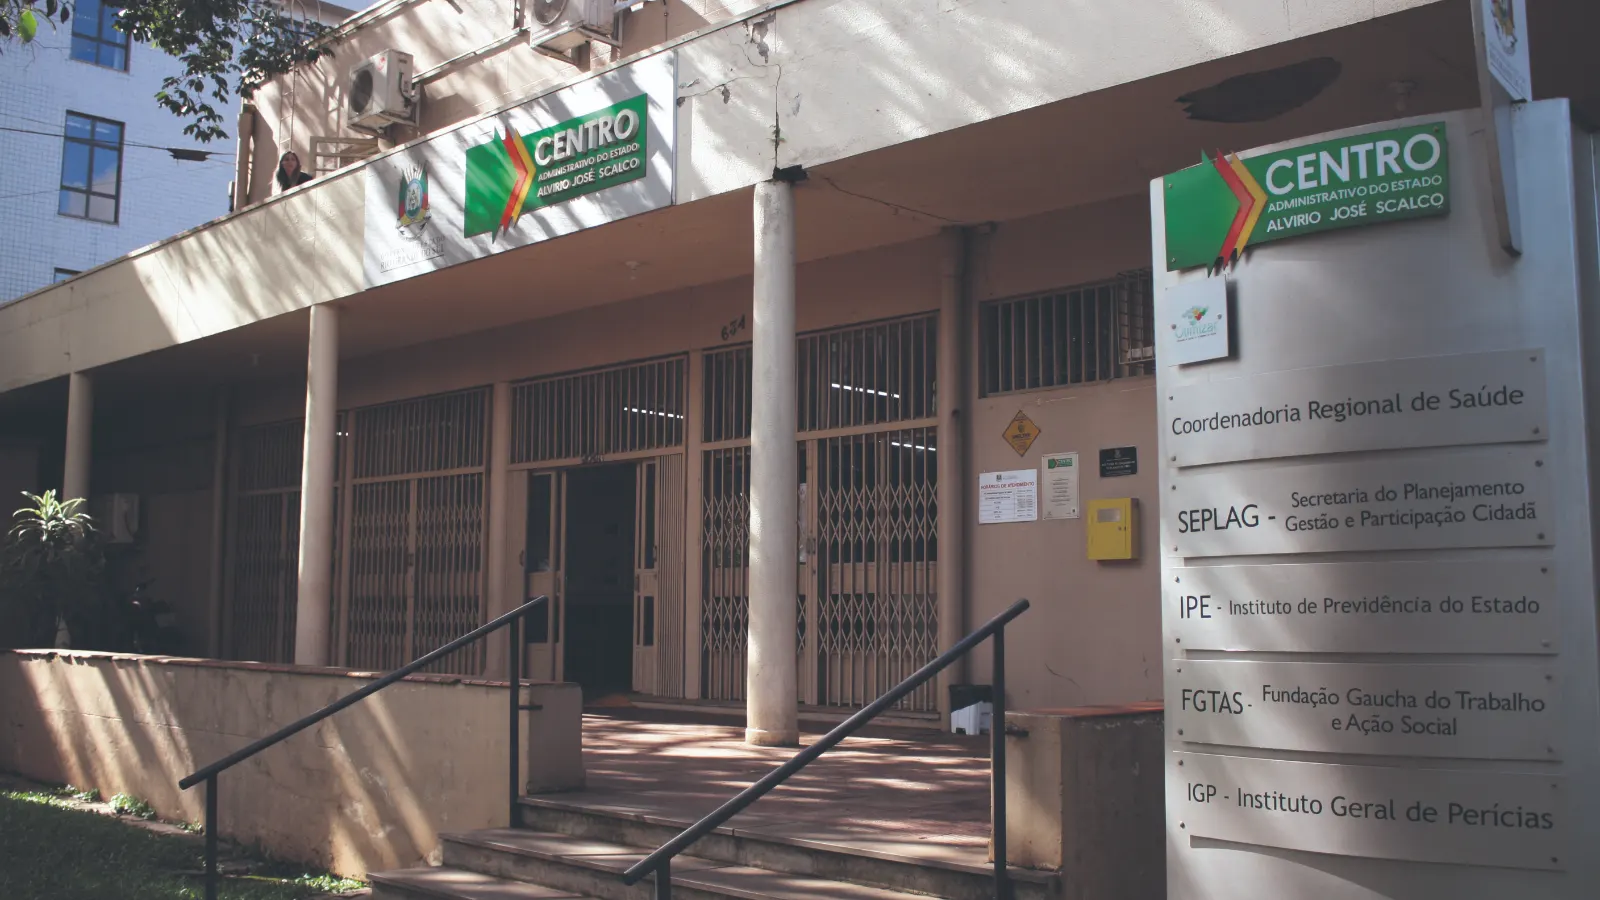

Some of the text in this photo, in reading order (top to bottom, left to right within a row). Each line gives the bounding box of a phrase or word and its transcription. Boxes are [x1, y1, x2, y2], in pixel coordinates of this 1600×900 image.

[534, 108, 639, 167] CENTRO
[537, 142, 640, 182] ADMINISTRATIVO DO ESTADO
[537, 157, 640, 198] ALVIRIO JOSÉ SCALCO
[1265, 133, 1441, 196] CENTRO
[1266, 193, 1444, 233] ALVIRIO JOSÉ SCALCO
[1267, 175, 1442, 213] ADMINISTRATIVO DO ESTADO
[1172, 384, 1524, 435] Coordenadoria Regional de Saúde
[1291, 482, 1525, 508] Secretaria do Planejamento
[1178, 503, 1260, 533] SEPLAG
[1285, 501, 1537, 532] Gestão e Participação Cidadã
[1180, 595, 1212, 619] IPE
[1229, 599, 1292, 615] Instituto
[1297, 598, 1317, 614] de
[1323, 595, 1431, 614] Previdência
[1439, 597, 1464, 614] do
[1471, 596, 1540, 614] Estado
[1262, 685, 1546, 712] Fundação Gaucha do Trabalho
[1331, 714, 1457, 736] e Ação Social
[1188, 782, 1217, 803] IGP
[1238, 787, 1323, 815] Instituto
[1331, 796, 1396, 821] Geral
[1406, 801, 1438, 823] de
[1448, 803, 1554, 830] Perícias
